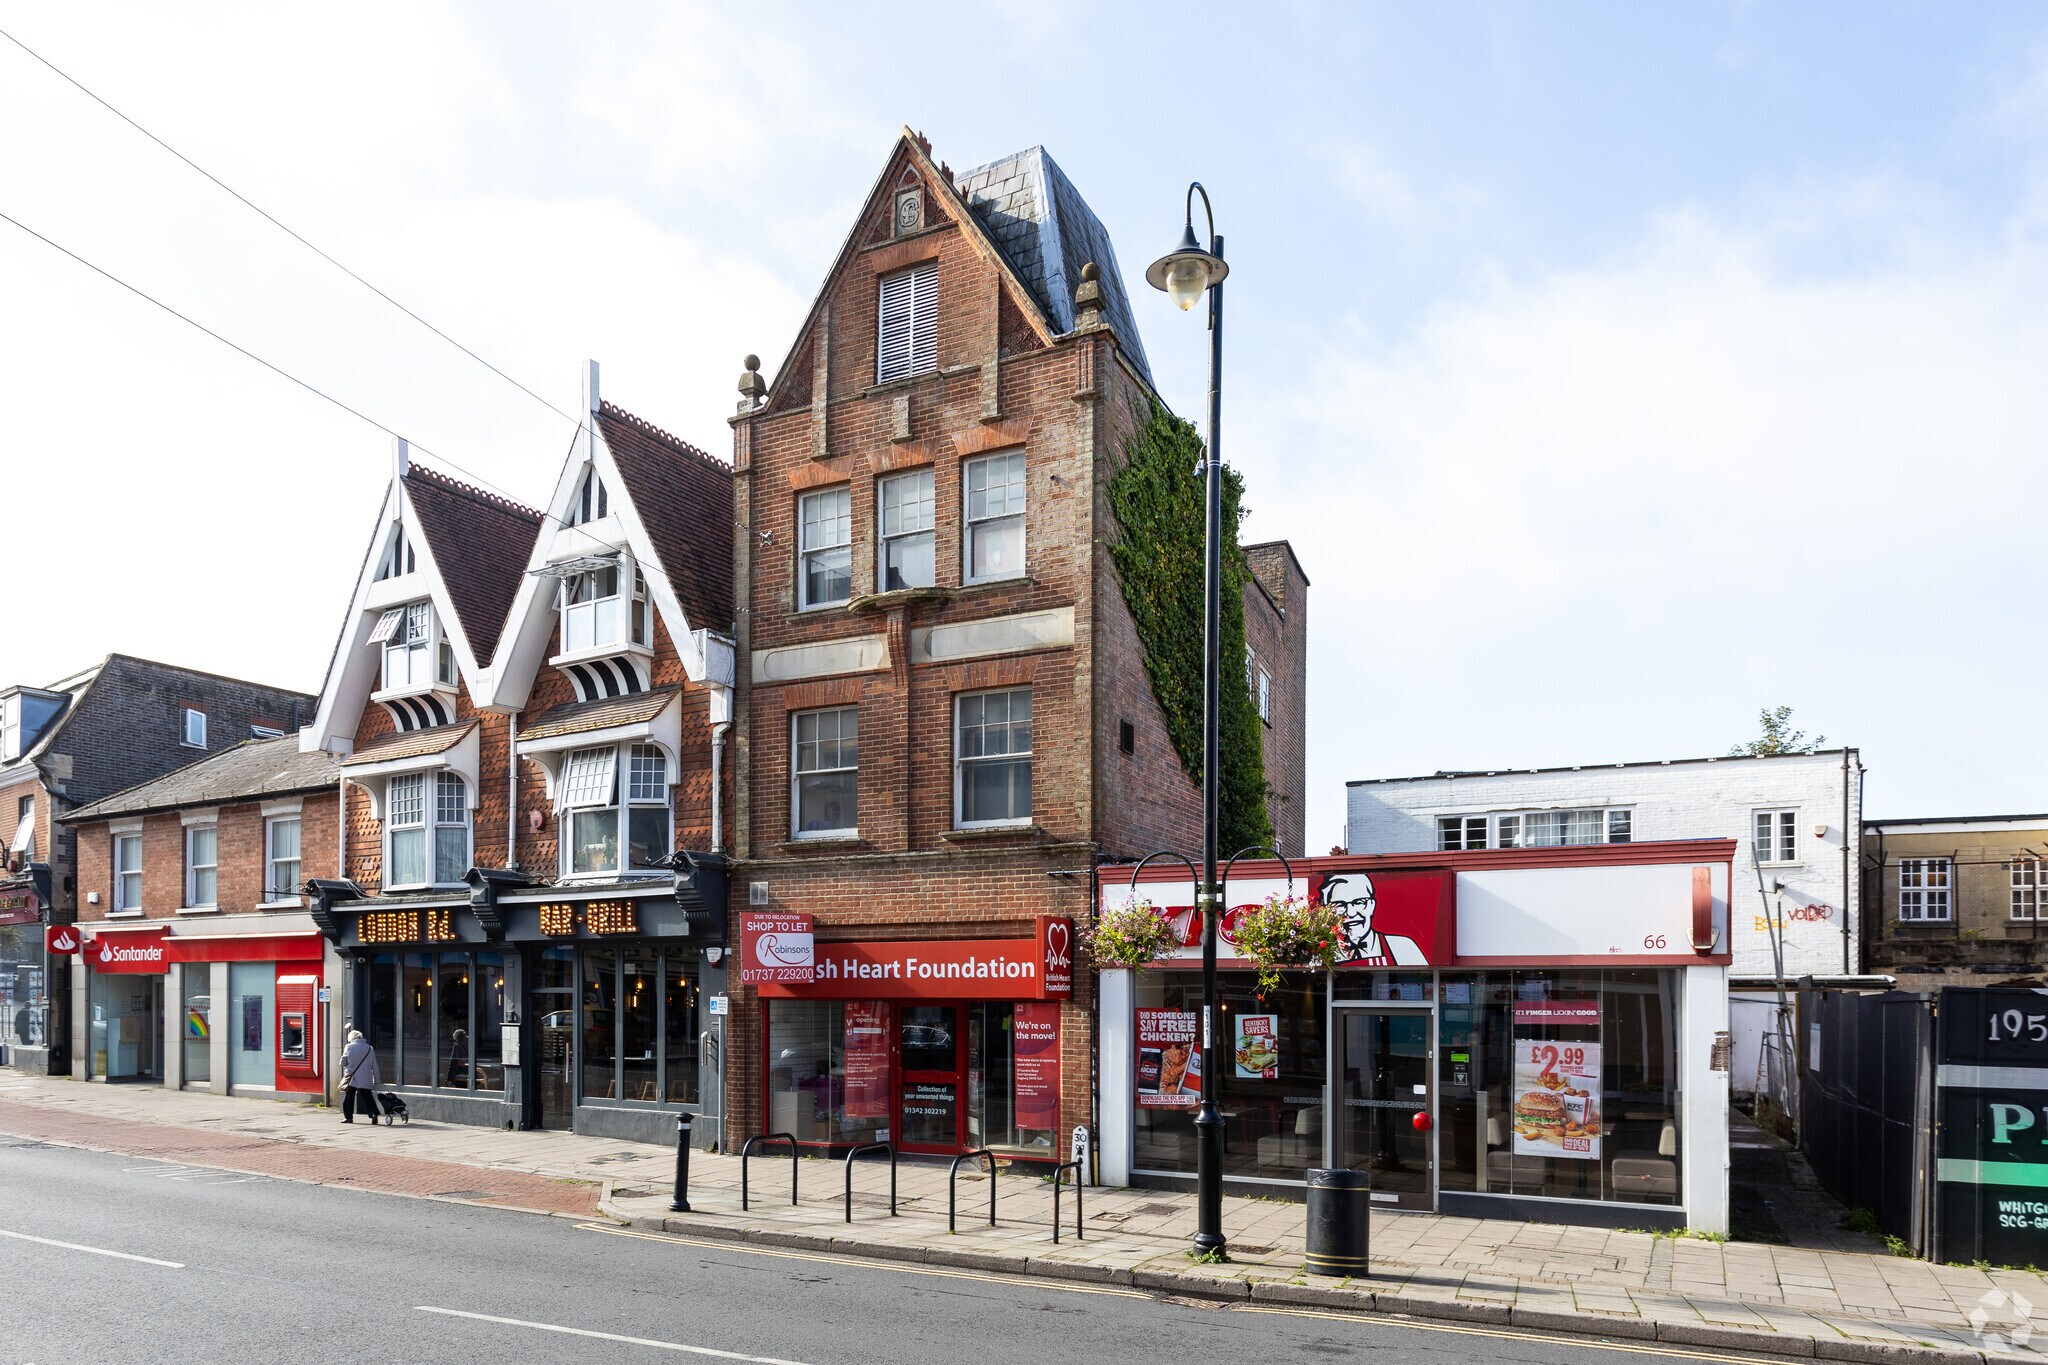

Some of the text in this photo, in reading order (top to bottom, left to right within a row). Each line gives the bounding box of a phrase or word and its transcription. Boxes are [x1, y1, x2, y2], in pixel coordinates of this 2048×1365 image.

[540, 901, 639, 936] BAR GRILL
[359, 911, 421, 943] LONDON
[747, 921, 808, 931] SHOP TO LET
[760, 935, 810, 959] Robinsons
[1644, 934, 1666, 949] 66
[113, 945, 163, 962] Santander
[816, 956, 1035, 978] sh Heart Foundation
[742, 968, 814, 980] 01737 229200
[1045, 982, 1070, 991] Foundation
[1016, 1021, 1039, 1030] We're
[1140, 1020, 1196, 1032] SAY FREE
[1244, 1019, 1268, 1027] KENTUCKY
[1988, 1009, 2048, 1041] 195
[1016, 1031, 1056, 1040] the move!
[1245, 1025, 1269, 1035] SAVERS
[1140, 1033, 1196, 1041] CHICKEN?
[1531, 1045, 1584, 1079] £2.99
[1567, 1102, 1583, 1110] KFC
[1989, 1103, 2048, 1145] P
[1074, 1133, 1087, 1142] 30
[1573, 1139, 1589, 1147] DEAL
